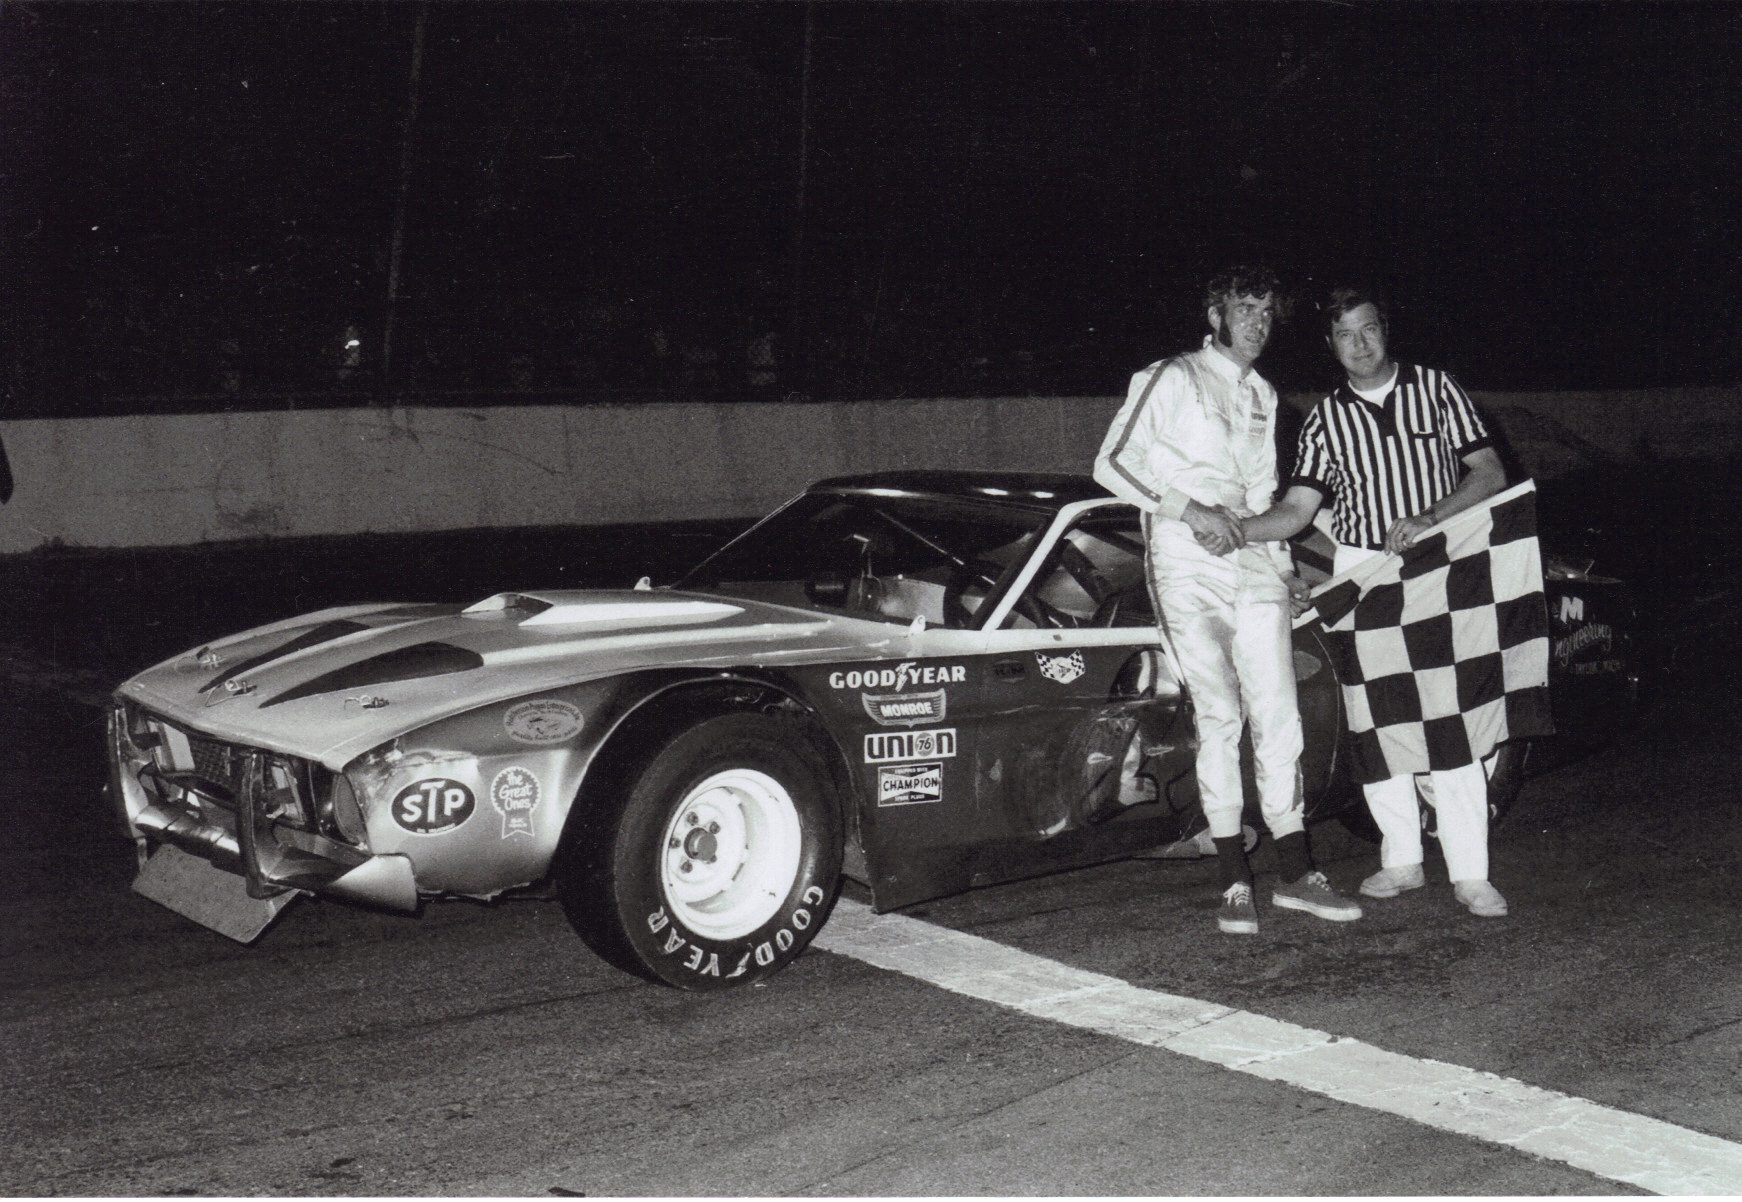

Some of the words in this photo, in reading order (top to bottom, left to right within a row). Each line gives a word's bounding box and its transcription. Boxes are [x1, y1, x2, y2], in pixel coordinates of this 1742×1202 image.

[1554, 621, 1612, 667] ngineering
[880, 702, 933, 717] MONROE
[918, 738, 931, 750] 76
[499, 784, 533, 799] Great
[883, 777, 938, 791] CHAMPION
[401, 780, 465, 823] STP
[504, 796, 531, 810] Ones
